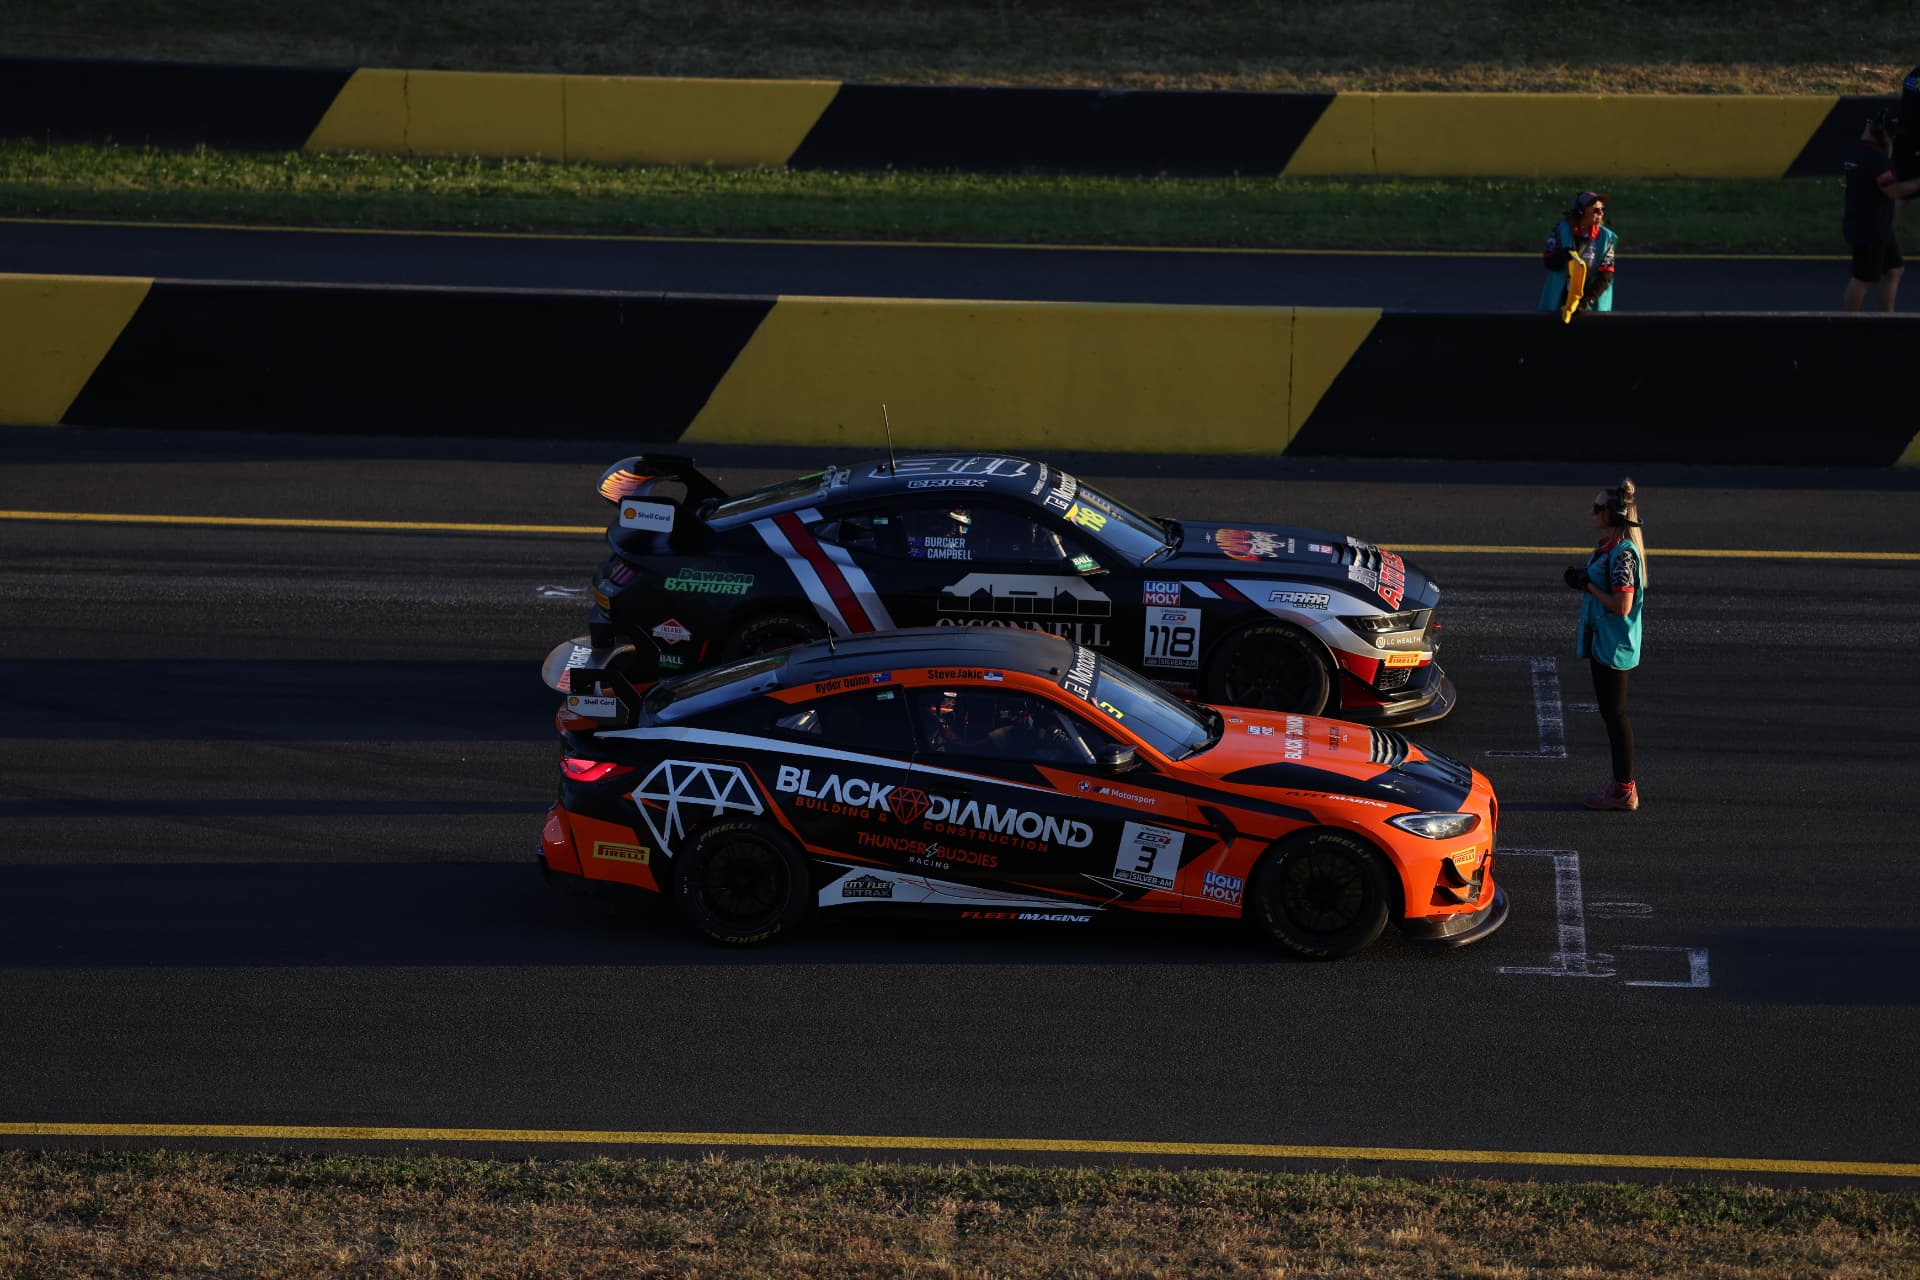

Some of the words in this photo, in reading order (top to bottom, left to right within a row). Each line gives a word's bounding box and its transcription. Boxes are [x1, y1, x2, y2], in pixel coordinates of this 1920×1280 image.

[638, 511, 653, 520] Shell
[654, 513, 671, 522] Card
[924, 536, 965, 548] BURCHER
[927, 548, 973, 561] CAMPBELL
[664, 577, 753, 595] BATHURST
[1145, 581, 1180, 593] LIQUI
[1144, 593, 1180, 606] MOLY
[1149, 625, 1196, 658] 118
[1397, 636, 1421, 645] WEALTH
[1388, 653, 1419, 664] PIRELLI
[815, 678, 842, 693] Ryder
[1111, 789, 1156, 805] Motorsport
[775, 764, 896, 813] BLACK
[924, 793, 1095, 849] DIAMOND
[795, 795, 871, 821] BUILDING
[878, 812, 888, 824] &
[922, 820, 1049, 854] CONSTRUCTION
[598, 844, 646, 861] PIRELLI
[1134, 845, 1157, 873] 3
[908, 855, 950, 870] RACING
[1204, 871, 1242, 890] LIQUI
[1202, 885, 1241, 901] MOLY
